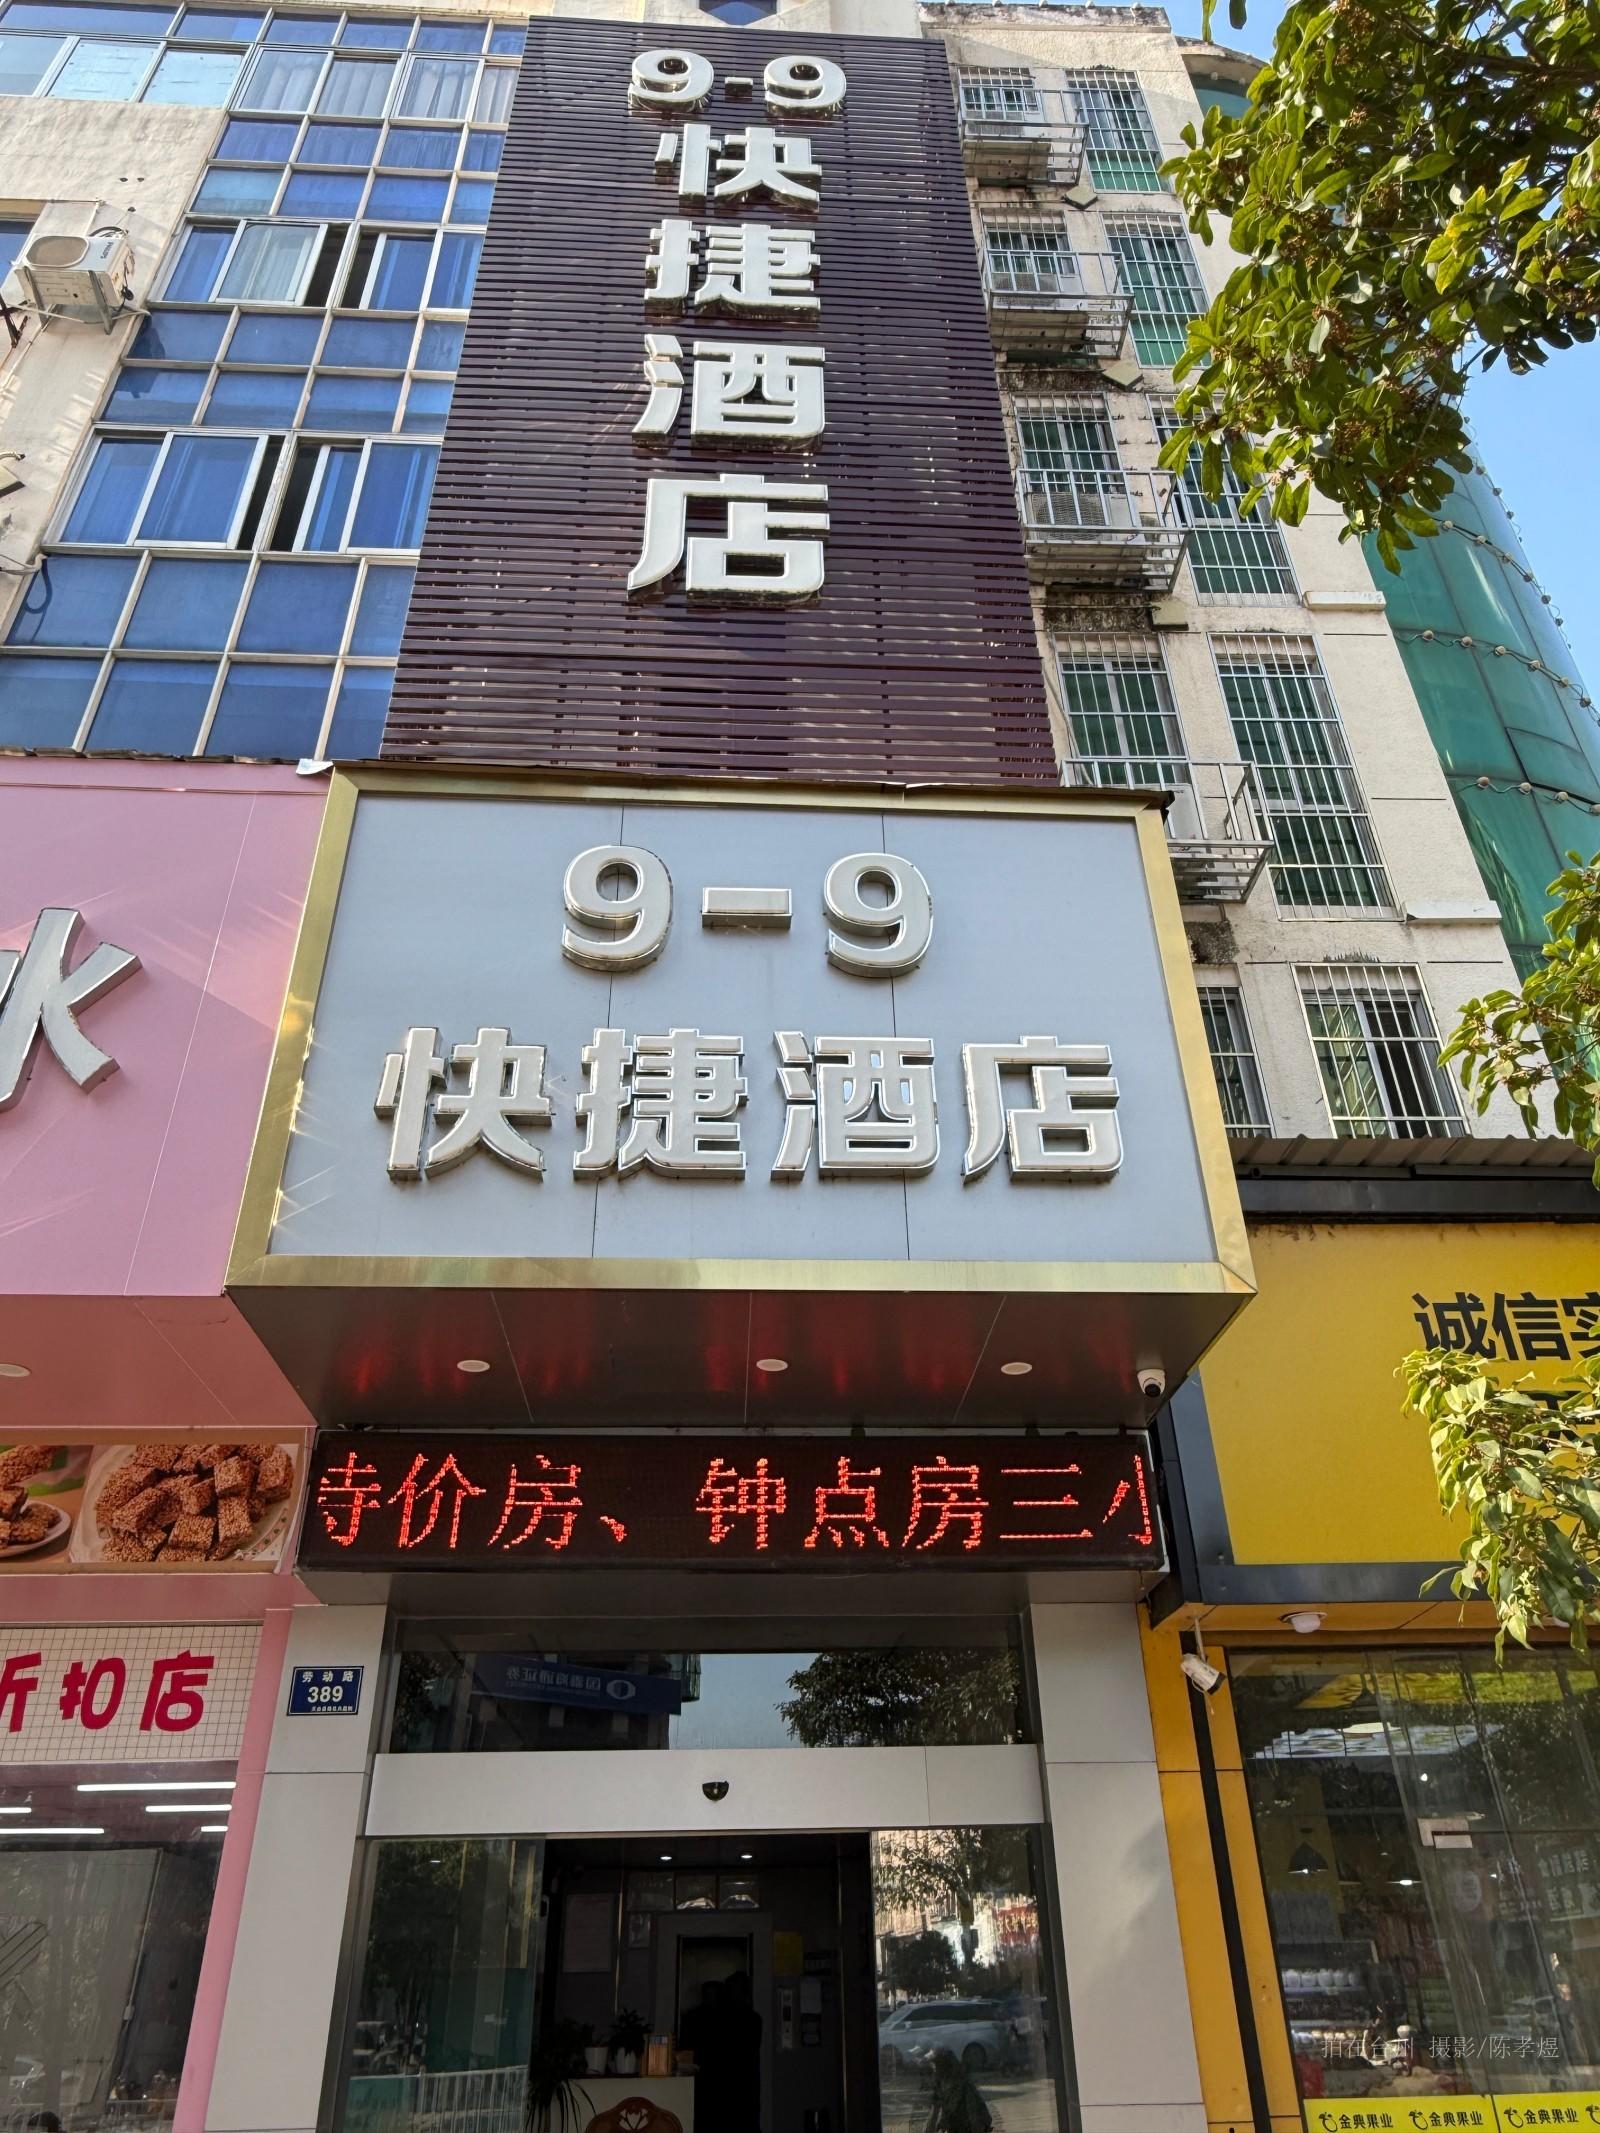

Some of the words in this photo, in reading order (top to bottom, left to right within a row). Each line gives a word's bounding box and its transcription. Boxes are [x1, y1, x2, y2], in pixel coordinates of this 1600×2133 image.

[628, 49, 847, 118] 9-9
[627, 124, 831, 607] 快捷酒店
[562, 845, 934, 977] 9-9
[375, 1027, 1124, 1183] 快捷酒店
[302, 1670, 354, 1683] 劳动路
[307, 1685, 344, 1704] 389
